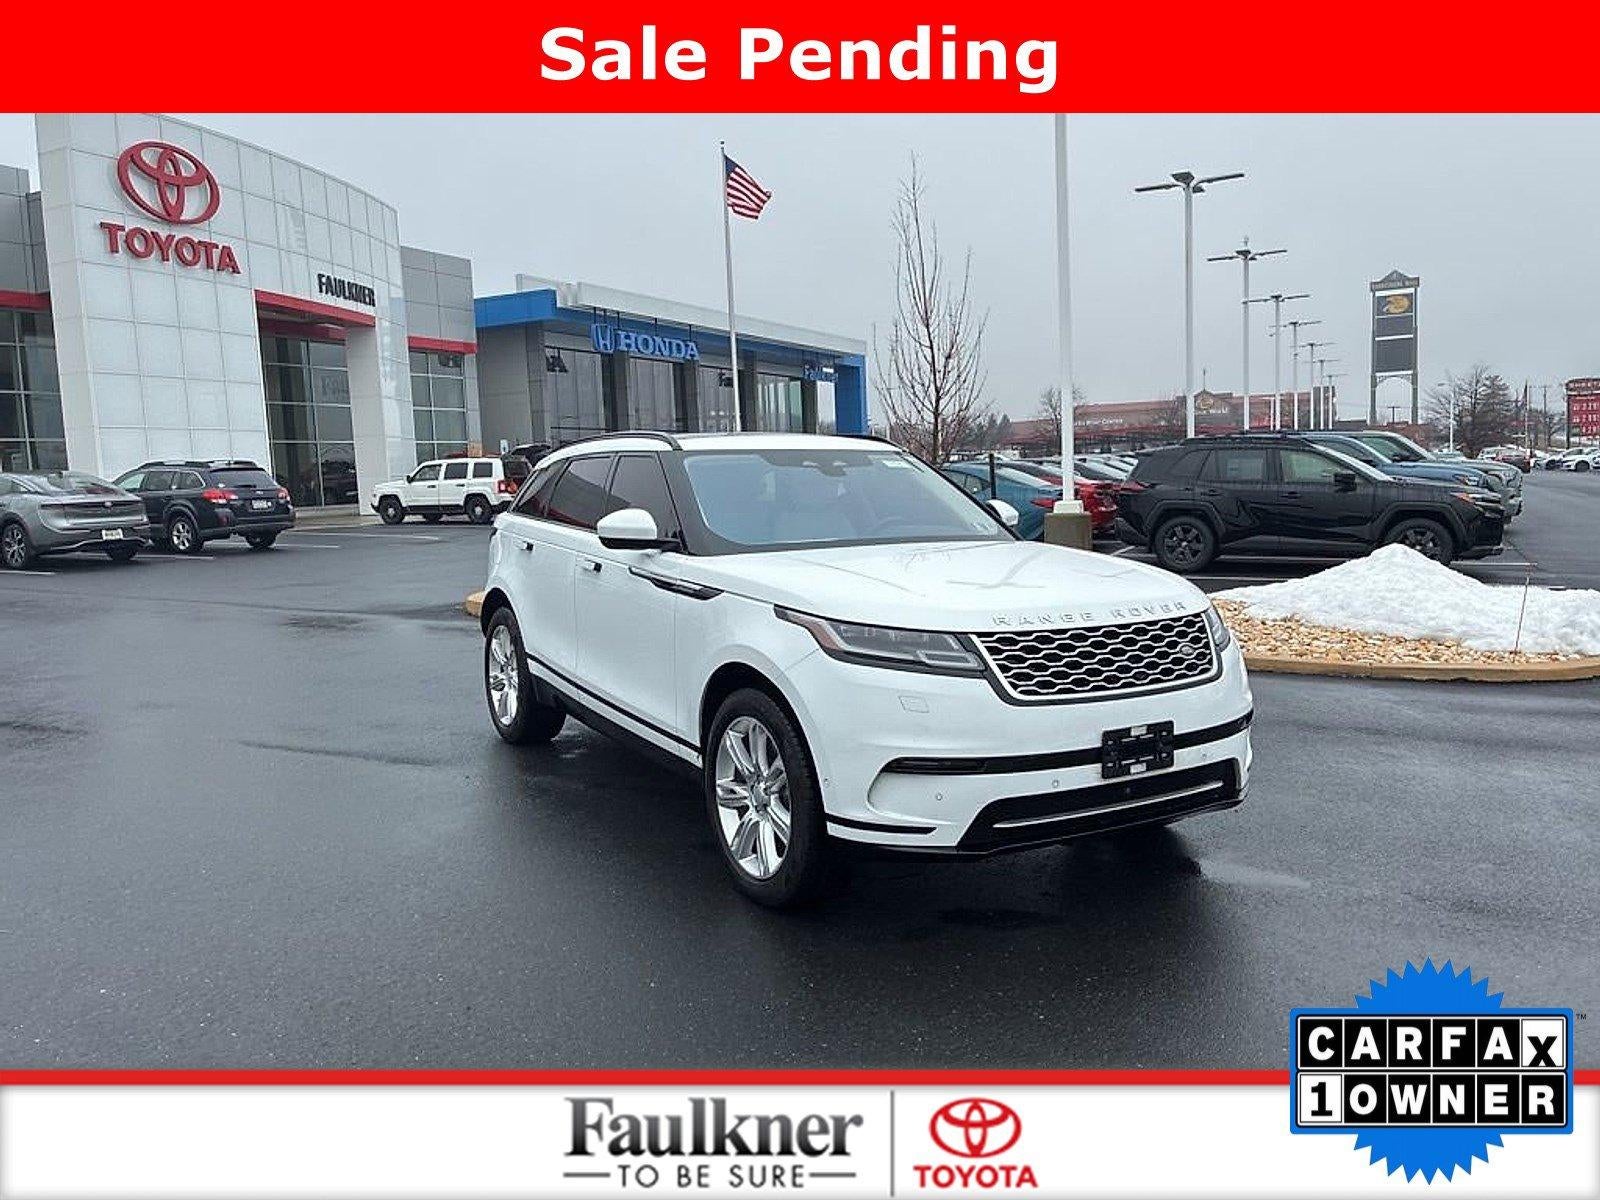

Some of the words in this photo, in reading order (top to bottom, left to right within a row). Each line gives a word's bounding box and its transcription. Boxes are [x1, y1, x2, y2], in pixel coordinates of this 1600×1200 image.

[100, 221, 241, 274] TOYOTA
[317, 273, 376, 307] FAULKNER
[617, 329, 699, 361] HONDA
[992, 612, 1094, 627] RANGE
[1109, 601, 1187, 620] ROVER
